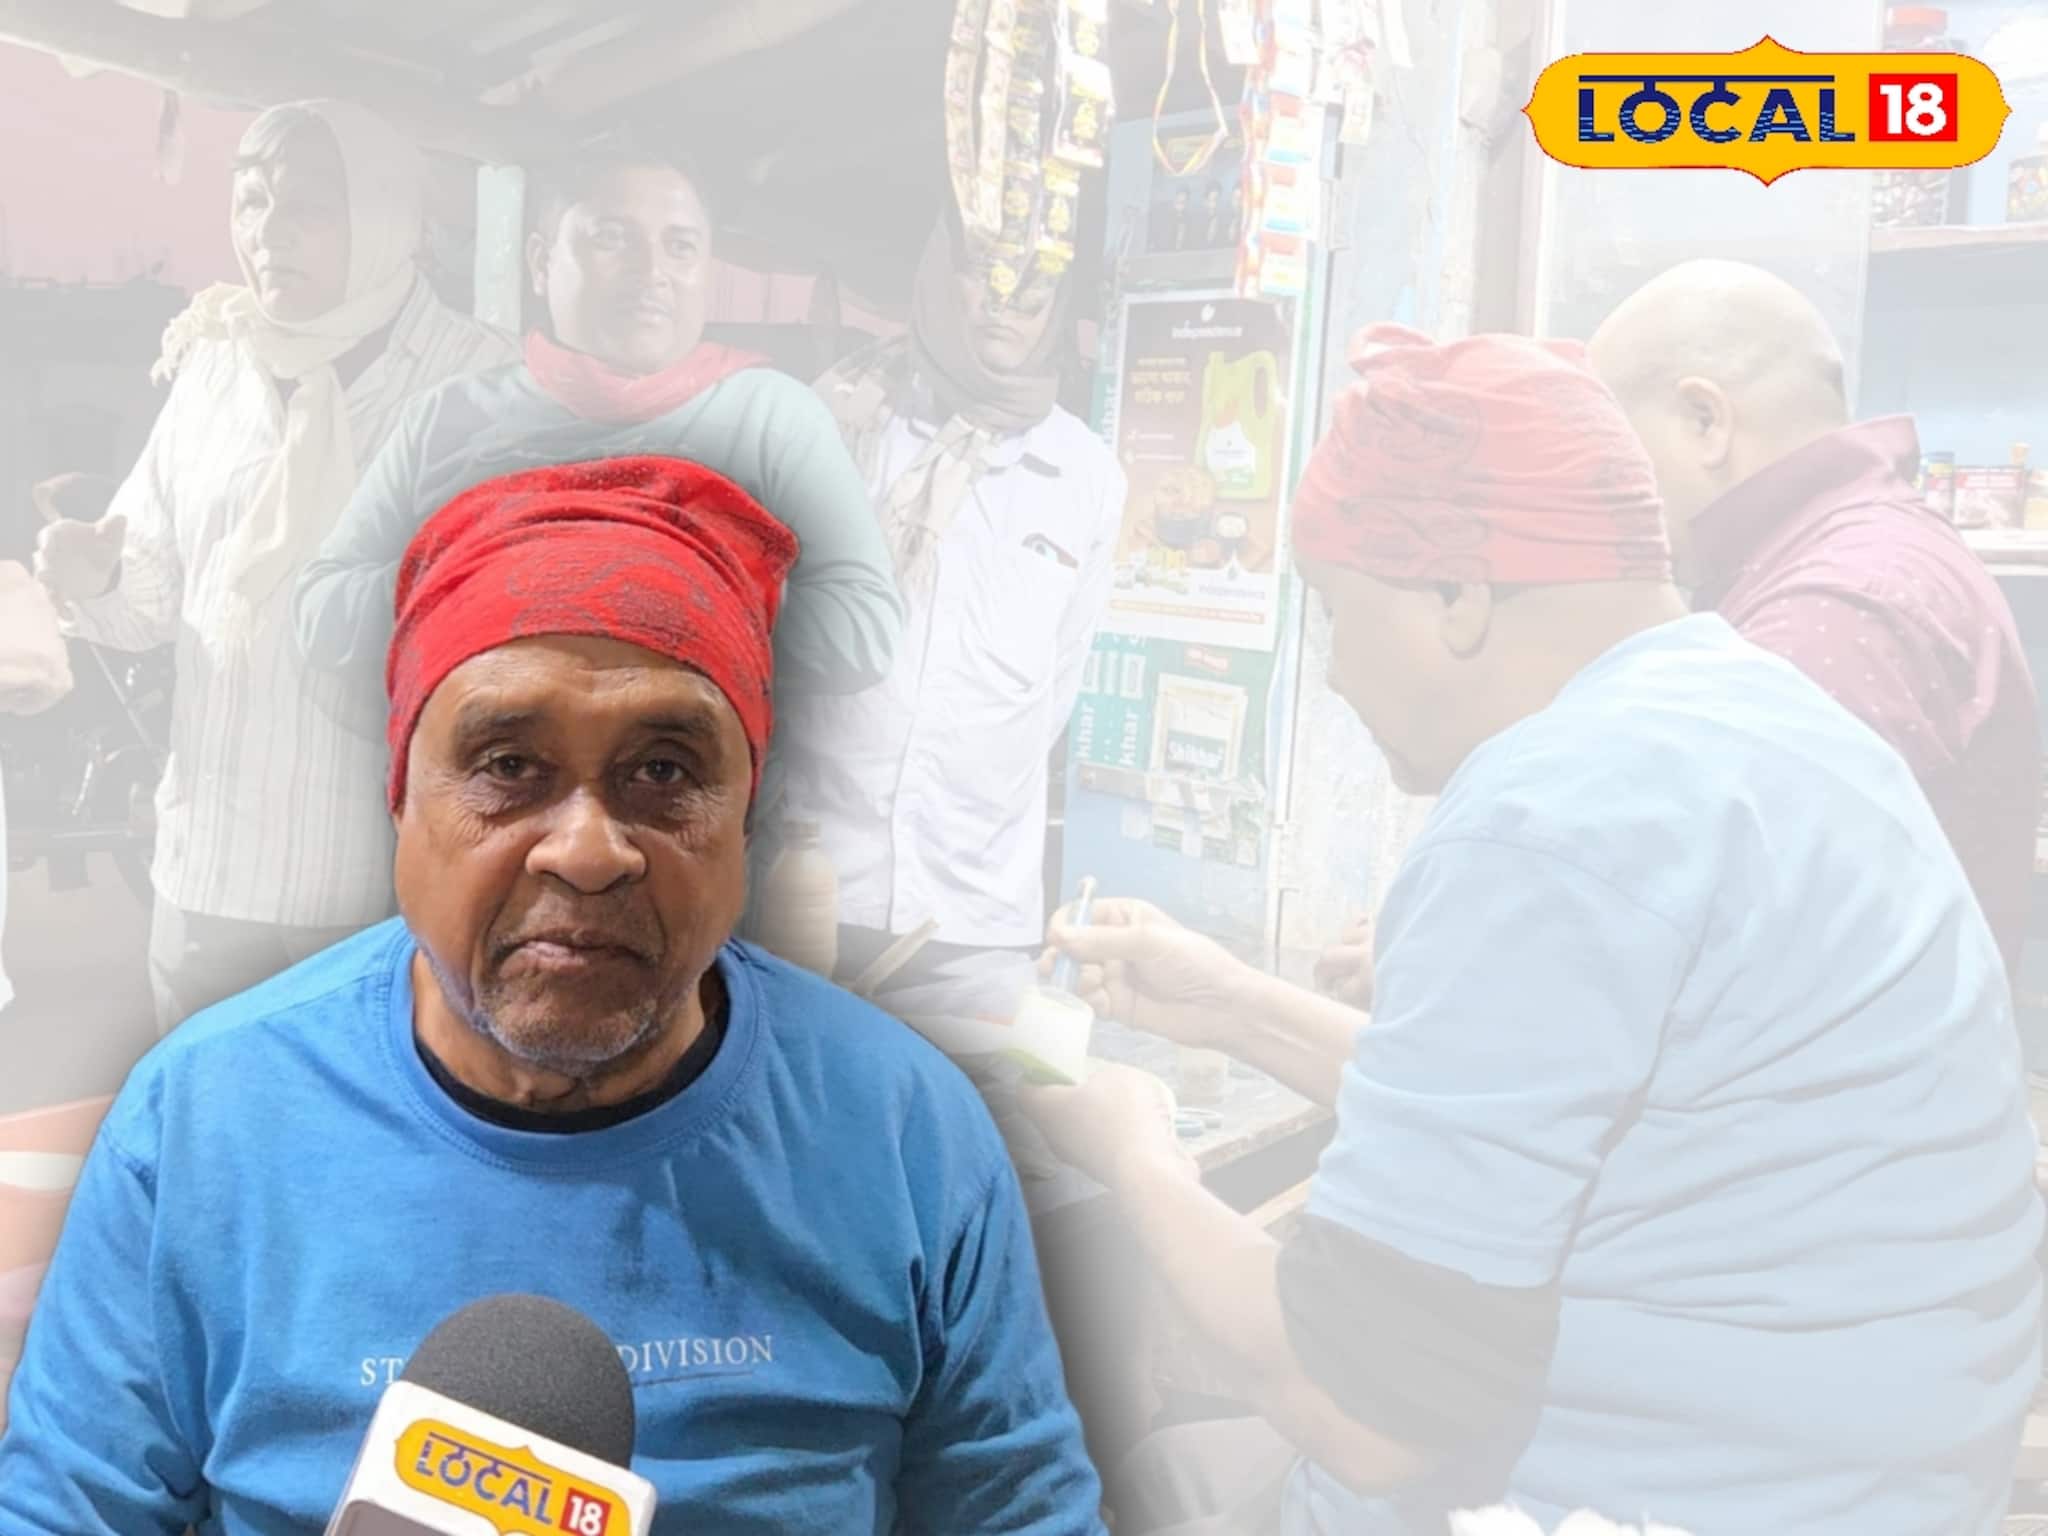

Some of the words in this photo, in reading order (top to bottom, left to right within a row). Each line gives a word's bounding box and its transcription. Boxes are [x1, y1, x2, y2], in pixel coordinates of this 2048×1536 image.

[360, 1357, 403, 1386] ST
[616, 1335, 773, 1372] DIVISION
[415, 1431, 553, 1525] LOCAL
[567, 1495, 604, 1536] 18
